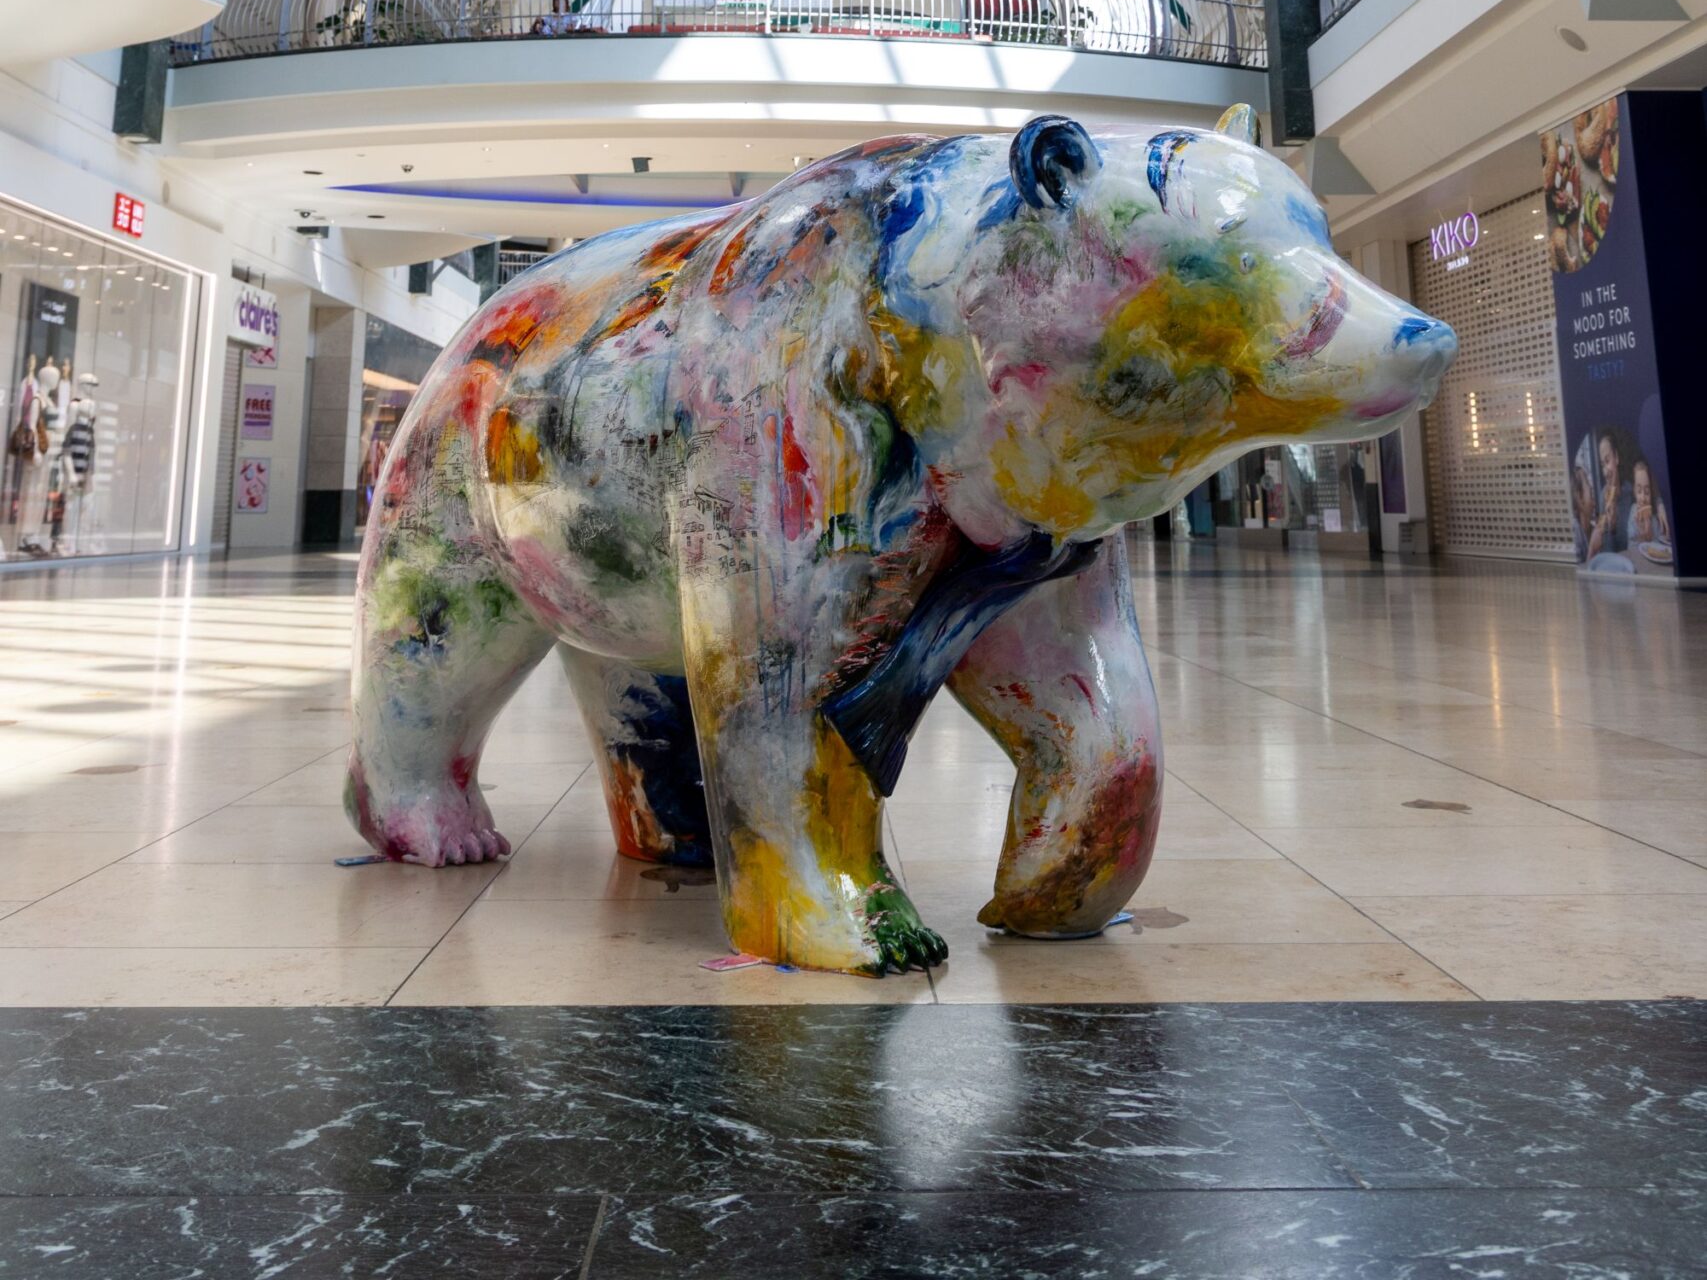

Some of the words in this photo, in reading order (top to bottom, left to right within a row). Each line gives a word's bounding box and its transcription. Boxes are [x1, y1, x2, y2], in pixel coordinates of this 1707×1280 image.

[1431, 212, 1478, 260] KIKO
[1581, 290, 1593, 308] IN
[1596, 283, 1617, 304] THE
[239, 292, 278, 336] claire's
[1573, 312, 1605, 335] MOOD
[1609, 306, 1631, 327] FOR
[1573, 331, 1636, 359] SOMETHING
[245, 398, 271, 412] FREE
